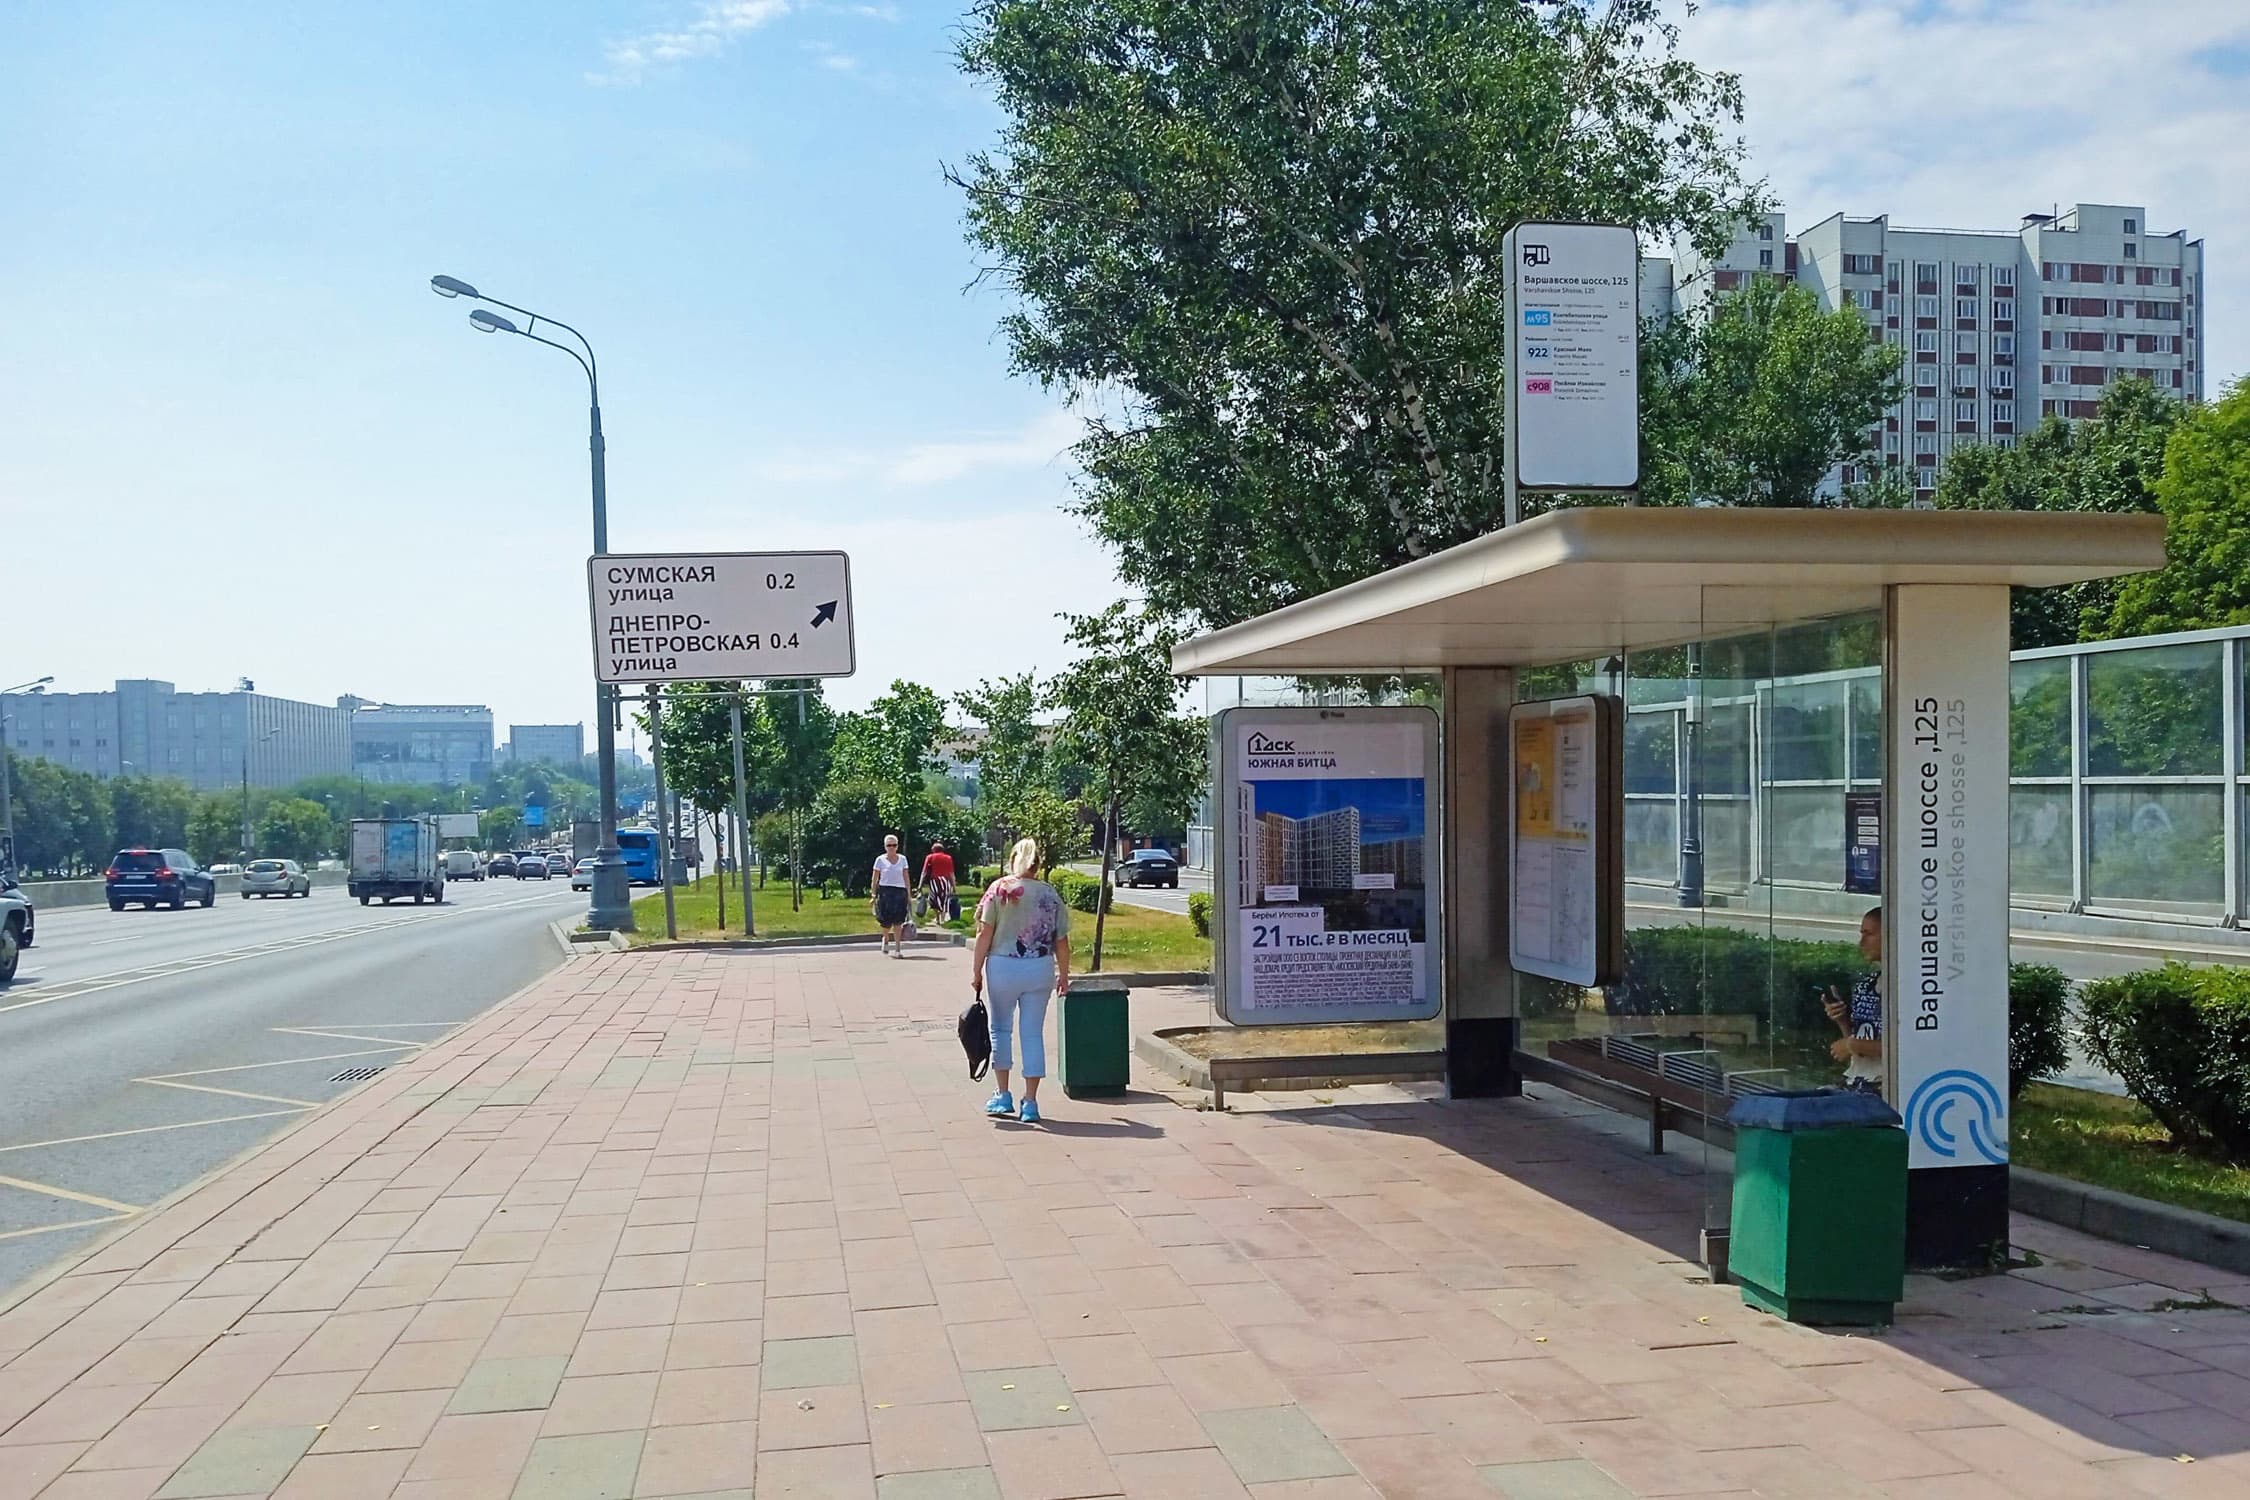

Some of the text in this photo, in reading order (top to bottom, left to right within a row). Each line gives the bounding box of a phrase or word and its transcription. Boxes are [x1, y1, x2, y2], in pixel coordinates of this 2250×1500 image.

[1524, 275, 1629, 287] Варшавское шоссе, 125
[1584, 287, 1595, 295] 125
[1528, 347, 1548, 358] 922
[608, 566, 795, 590] СУМСКАЯ 0.2
[609, 588, 673, 605] улица
[609, 614, 710, 635] ДНЕПРО-
[611, 632, 799, 654] ПЕТРОВСКАЯ 0.4
[612, 657, 677, 675] улица
[1248, 758, 1336, 770] ЮЖНАЯ БИТЦА
[1946, 755, 1966, 828] shosse
[1921, 761, 1939, 849] шоссе
[1278, 911, 1310, 919] Ипотека
[1946, 838, 1966, 982] Varshavskoe
[1252, 925, 1281, 948] 21
[1286, 934, 1323, 947] тыс.
[1338, 934, 1349, 945] в
[1353, 931, 1409, 947] месяц
[1916, 857, 1943, 1031] Варшавское
